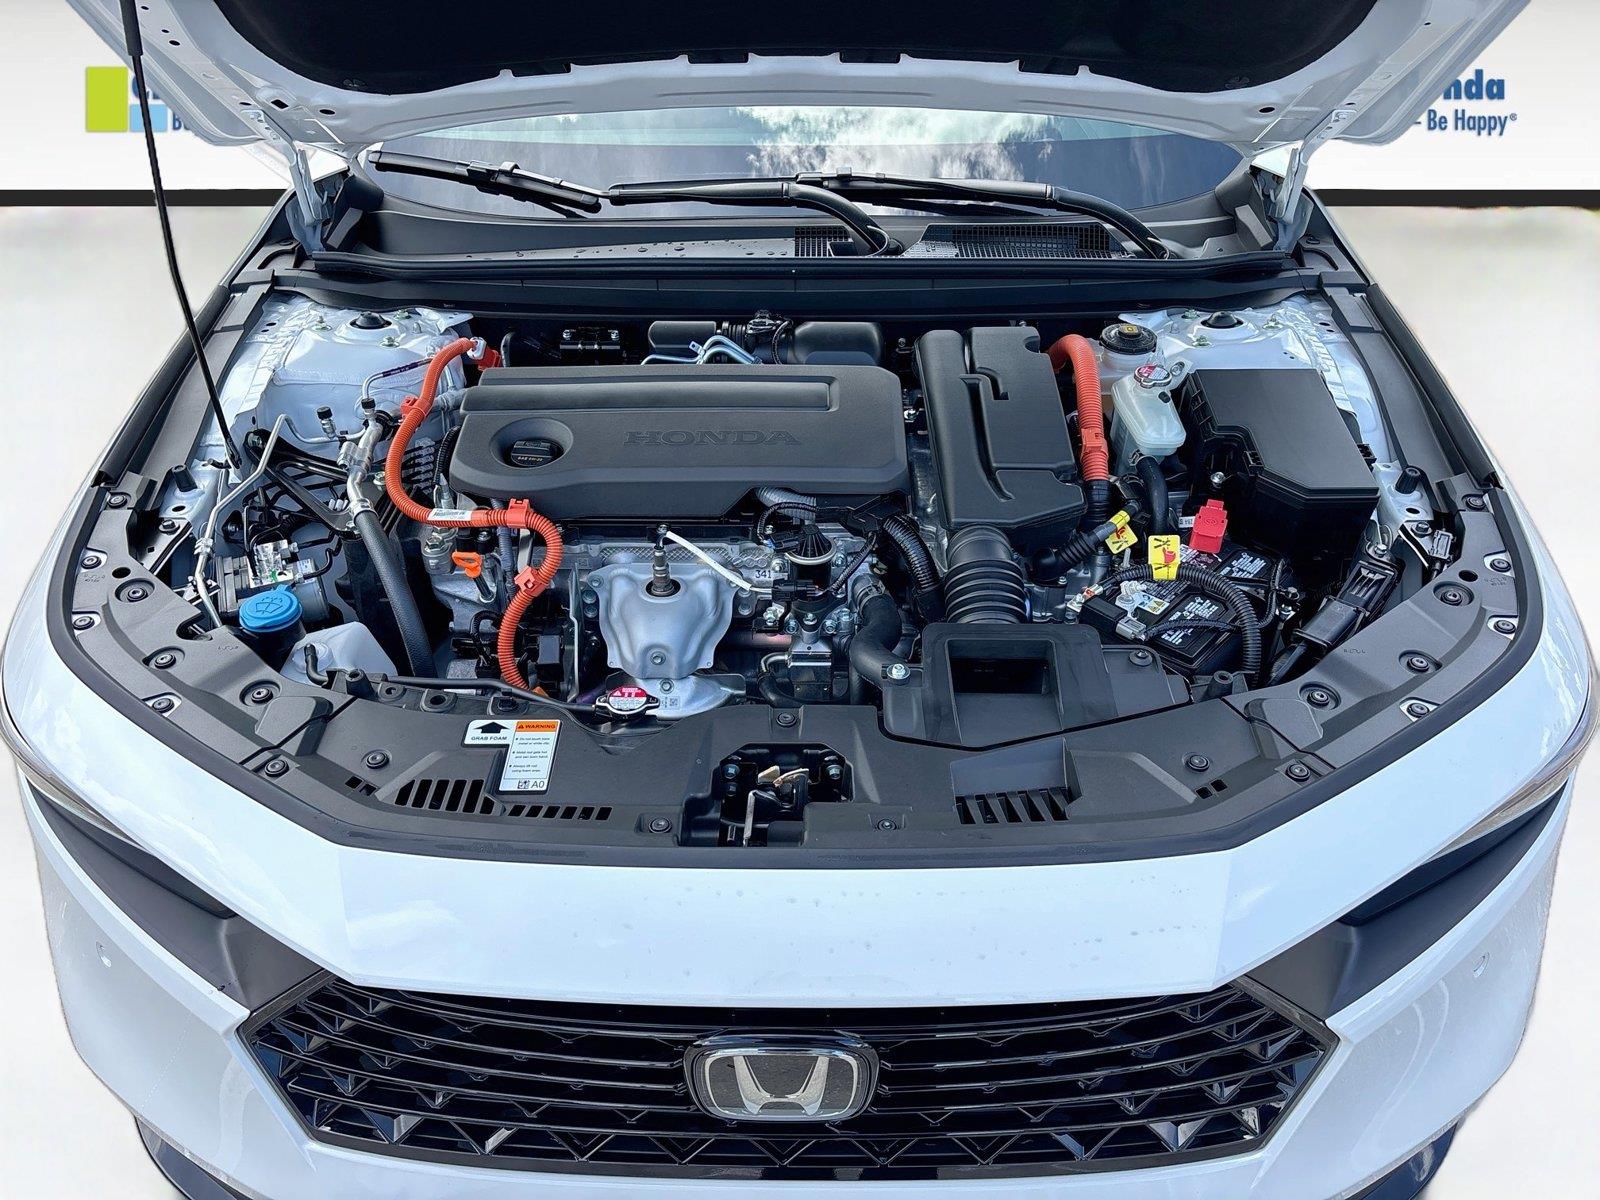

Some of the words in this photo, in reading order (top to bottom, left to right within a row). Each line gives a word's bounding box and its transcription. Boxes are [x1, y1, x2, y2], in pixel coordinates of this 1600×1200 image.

[1443, 69, 1505, 100] nda
[1427, 109, 1448, 131] Be
[623, 430, 802, 446] HONDA
[755, 569, 772, 579] 341
[530, 780, 545, 789] A0
